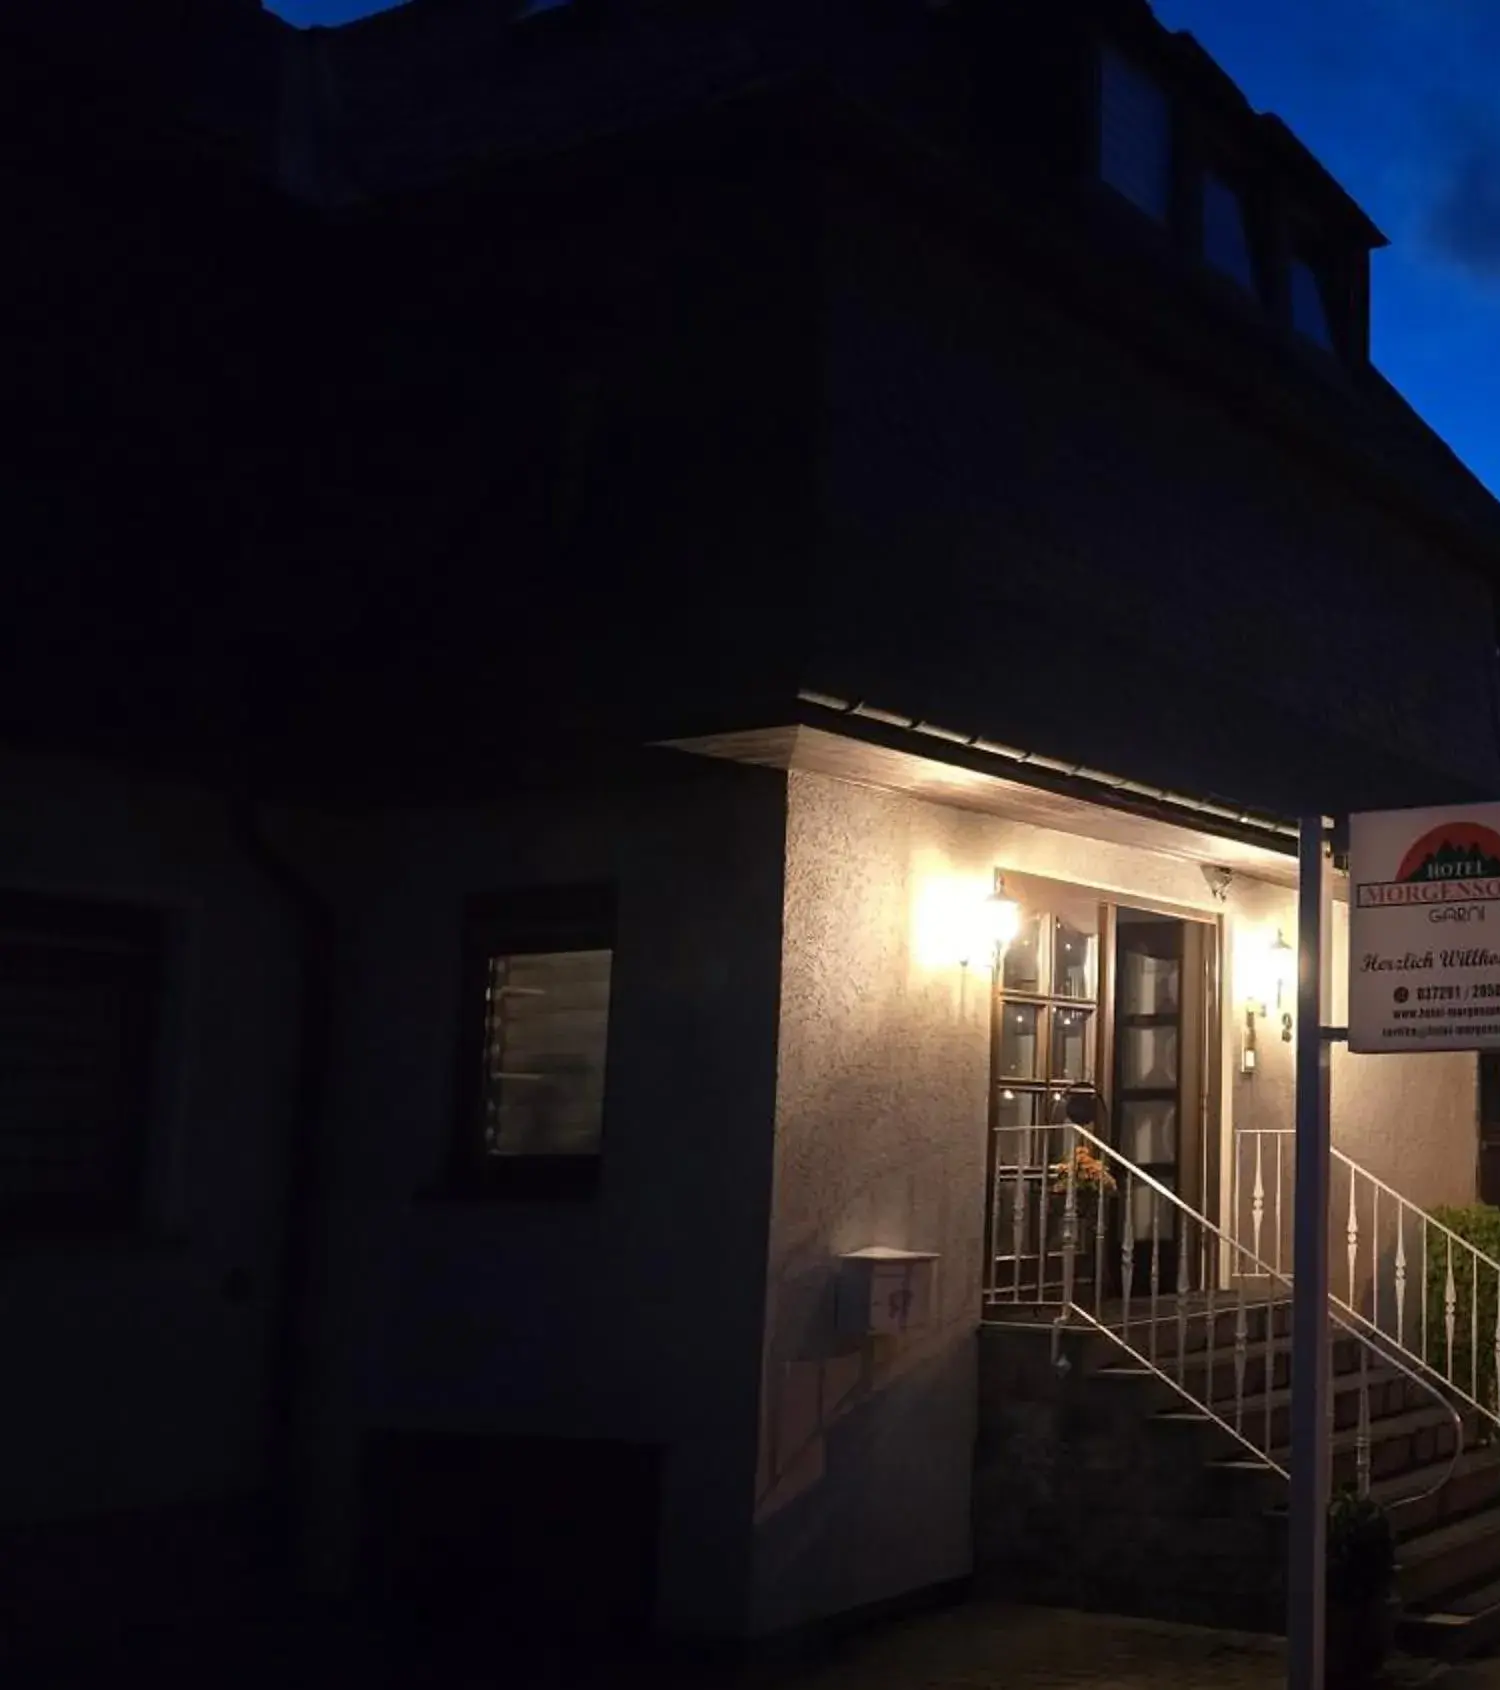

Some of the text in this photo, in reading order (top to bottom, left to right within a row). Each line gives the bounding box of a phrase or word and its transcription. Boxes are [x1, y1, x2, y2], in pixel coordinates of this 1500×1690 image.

[1427, 859, 1485, 879] HOTEL
[1428, 905, 1486, 923] GARNI
[1360, 951, 1434, 973] Herzlich
